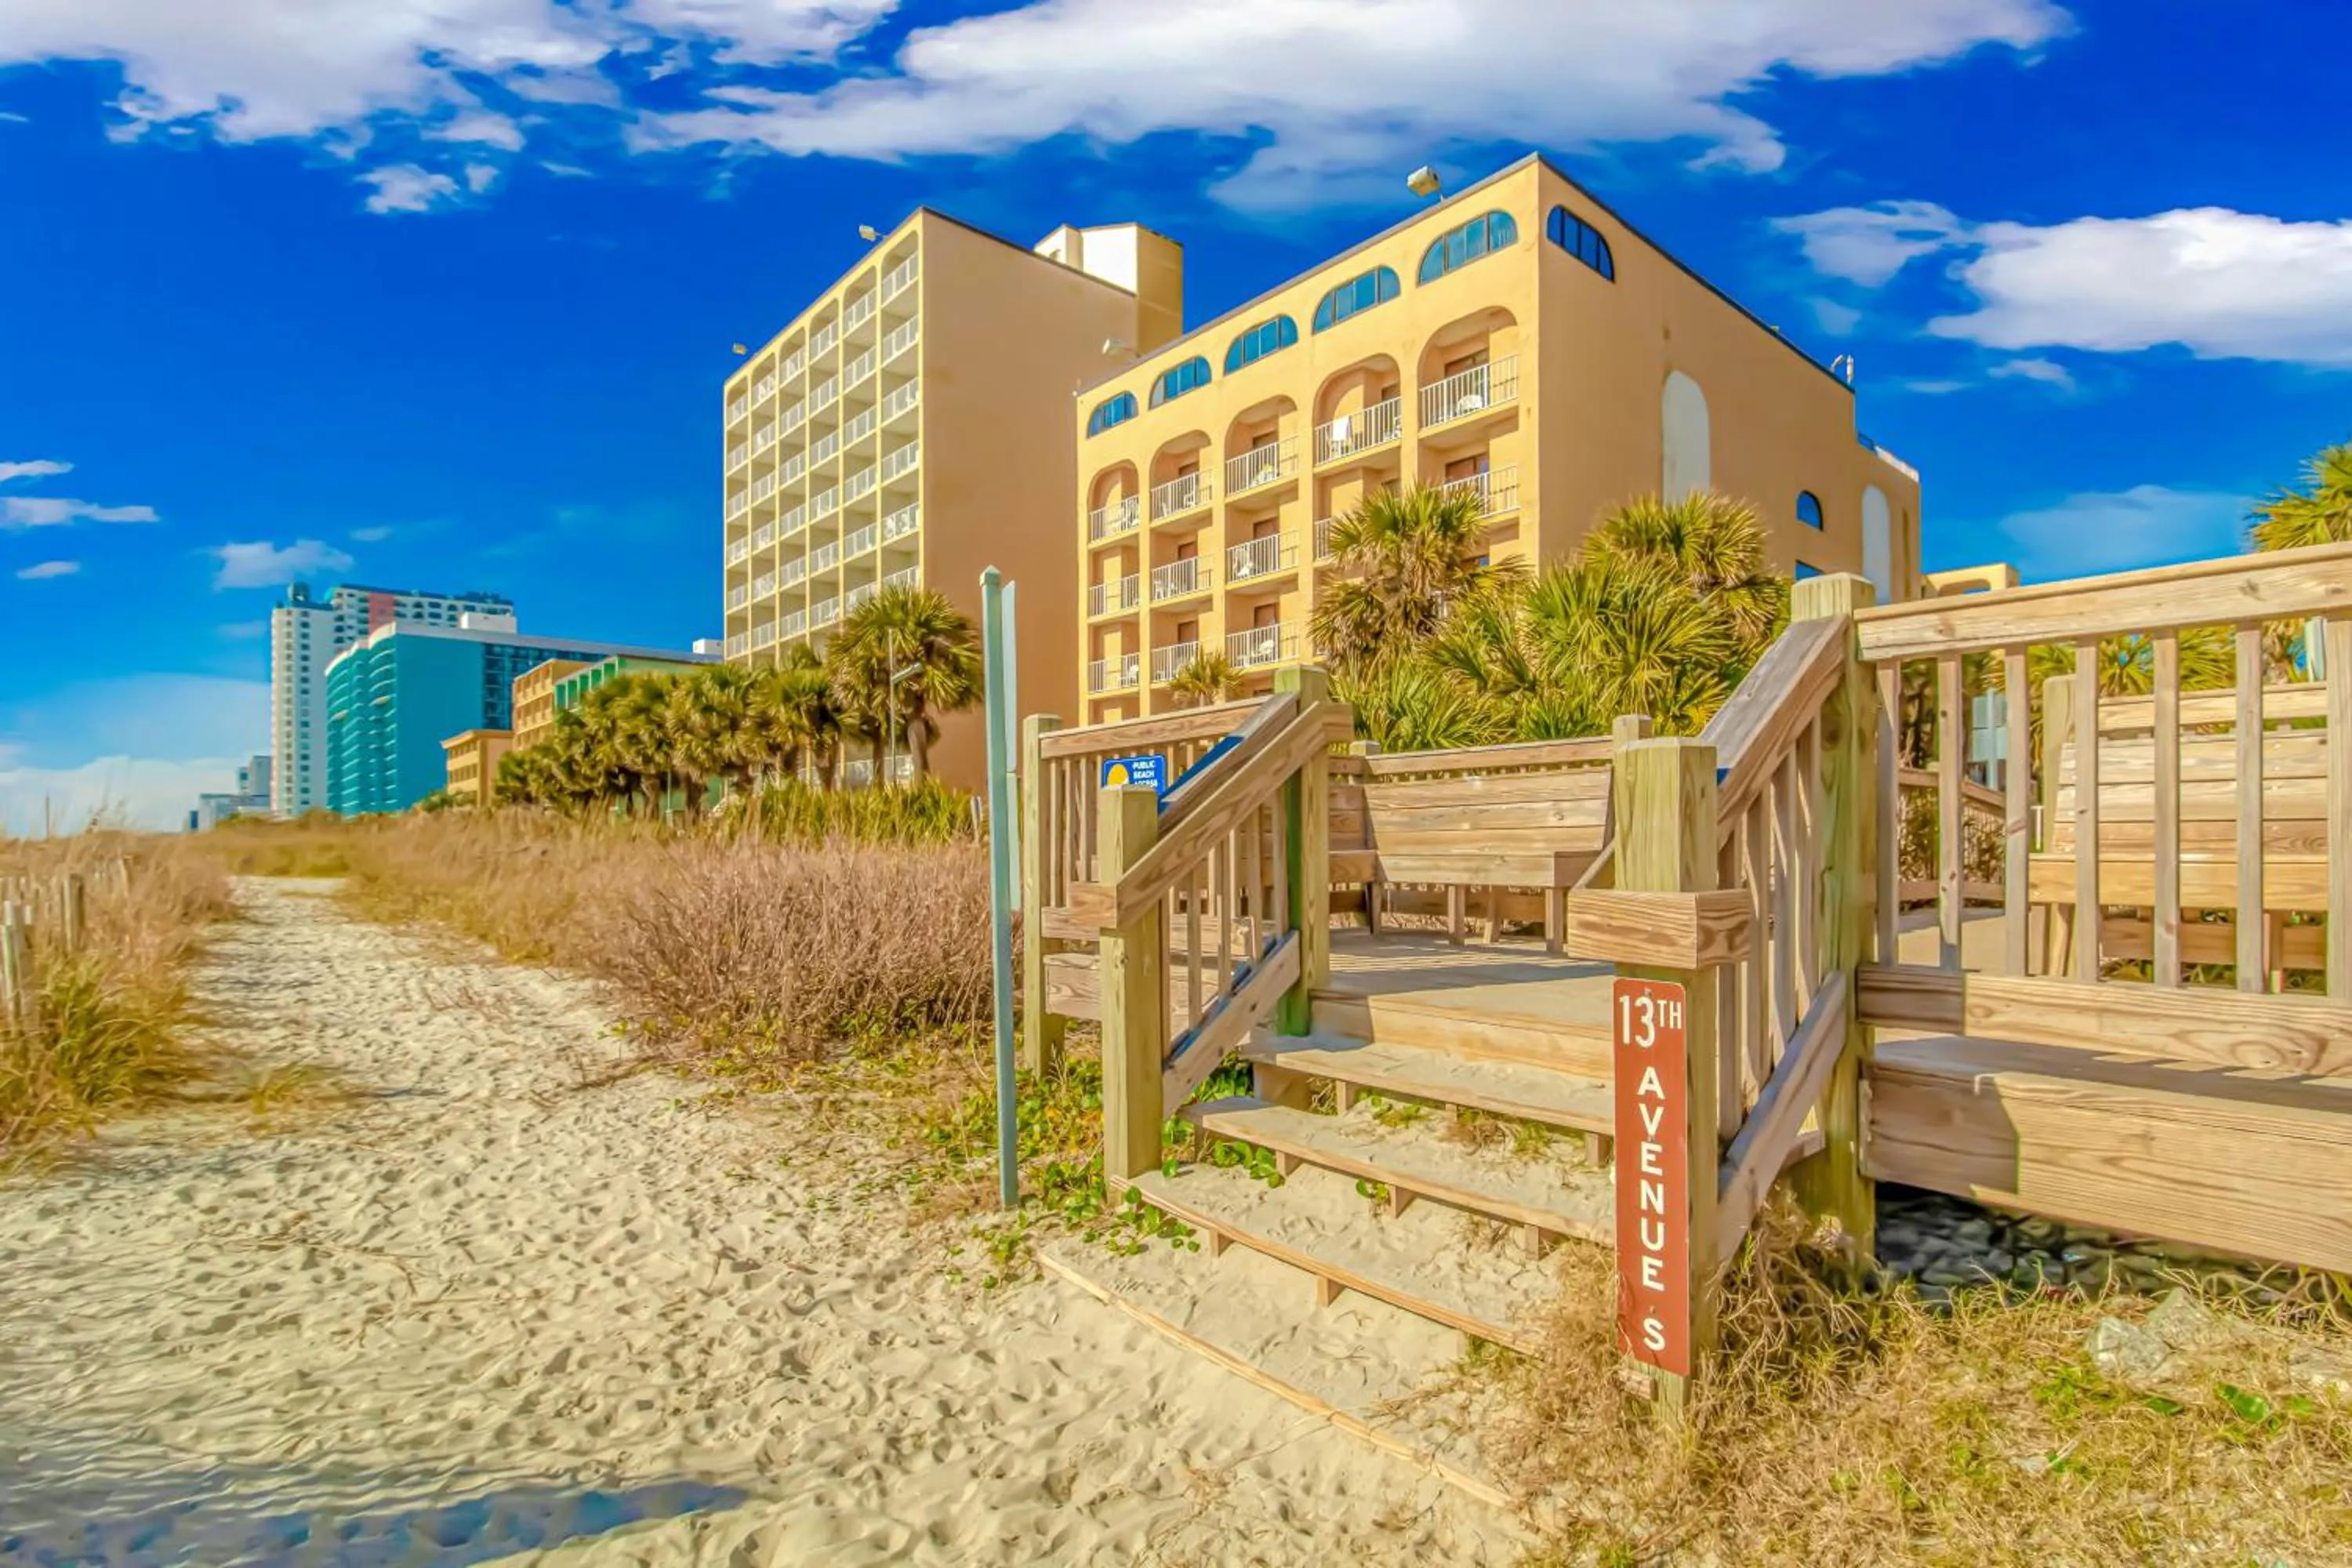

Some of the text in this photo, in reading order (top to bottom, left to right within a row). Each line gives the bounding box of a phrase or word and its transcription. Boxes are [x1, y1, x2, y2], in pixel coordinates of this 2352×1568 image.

[1132, 760, 1155, 769] PUBLIC
[1133, 770, 1155, 779] BEACH
[1618, 994, 1682, 1048] 13TH
[1636, 1065, 1666, 1352] AVENUE S
